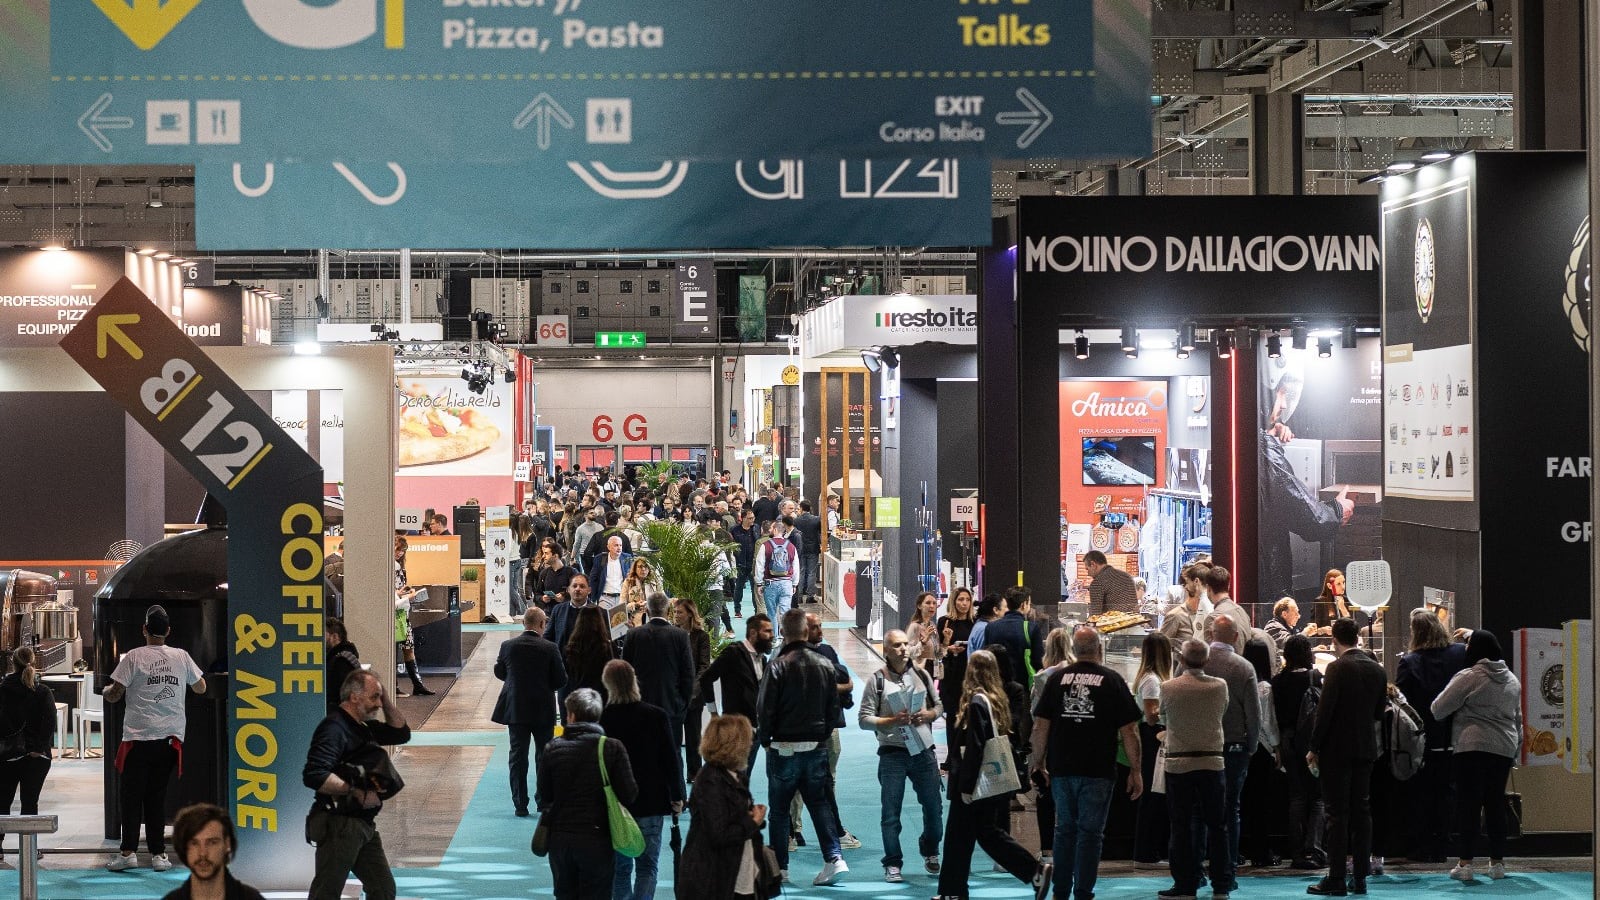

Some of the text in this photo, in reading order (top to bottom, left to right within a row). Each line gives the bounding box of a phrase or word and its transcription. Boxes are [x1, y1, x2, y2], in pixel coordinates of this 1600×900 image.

[442, 17, 664, 53] Pizza, Pasta
[957, 13, 1051, 46] Talks
[935, 95, 984, 116] EXIT
[879, 119, 986, 142] Corso Italia
[1025, 235, 1158, 272] MOLINO
[188, 266, 198, 279] 6
[688, 266, 698, 279] 6
[684, 291, 708, 321] E
[540, 323, 567, 339] 6G
[1071, 391, 1148, 417] Amica
[140, 358, 264, 485] 8 12
[400, 515, 418, 524] E03
[956, 505, 973, 514] E02
[280, 502, 324, 694] COFFEE
[147, 675, 161, 685] OGGI
[165, 675, 179, 686] PIZZA
[1060, 672, 1104, 687] NO SIGNAL
[234, 613, 278, 833] & MORE
